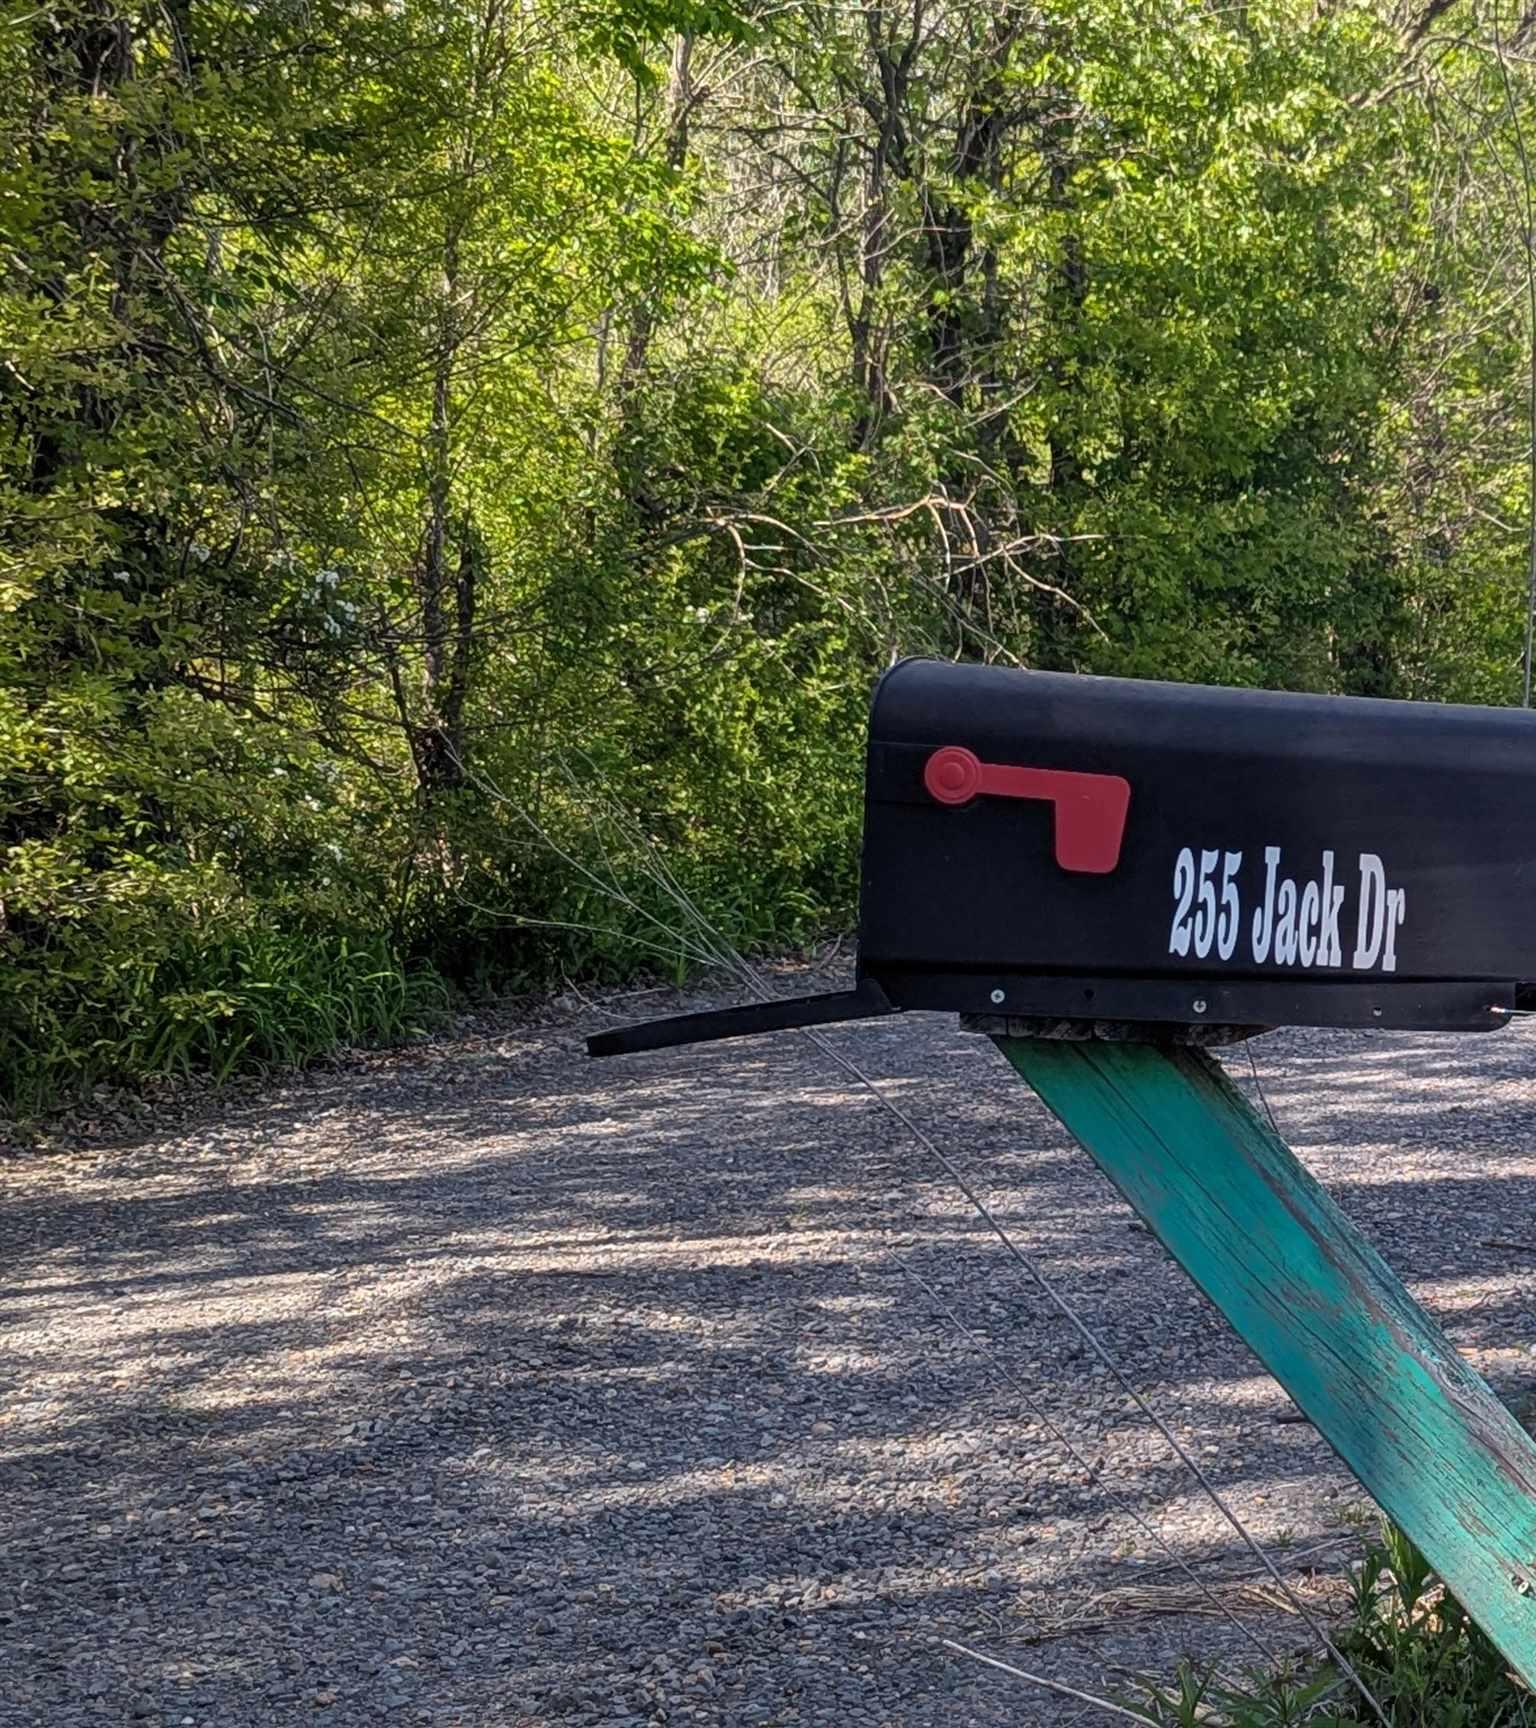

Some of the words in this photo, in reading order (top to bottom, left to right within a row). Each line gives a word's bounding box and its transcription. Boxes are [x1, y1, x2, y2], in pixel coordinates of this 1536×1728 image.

[1168, 847, 1242, 961] 255
[1252, 846, 1345, 968] Jack
[1352, 853, 1406, 972] Dr
